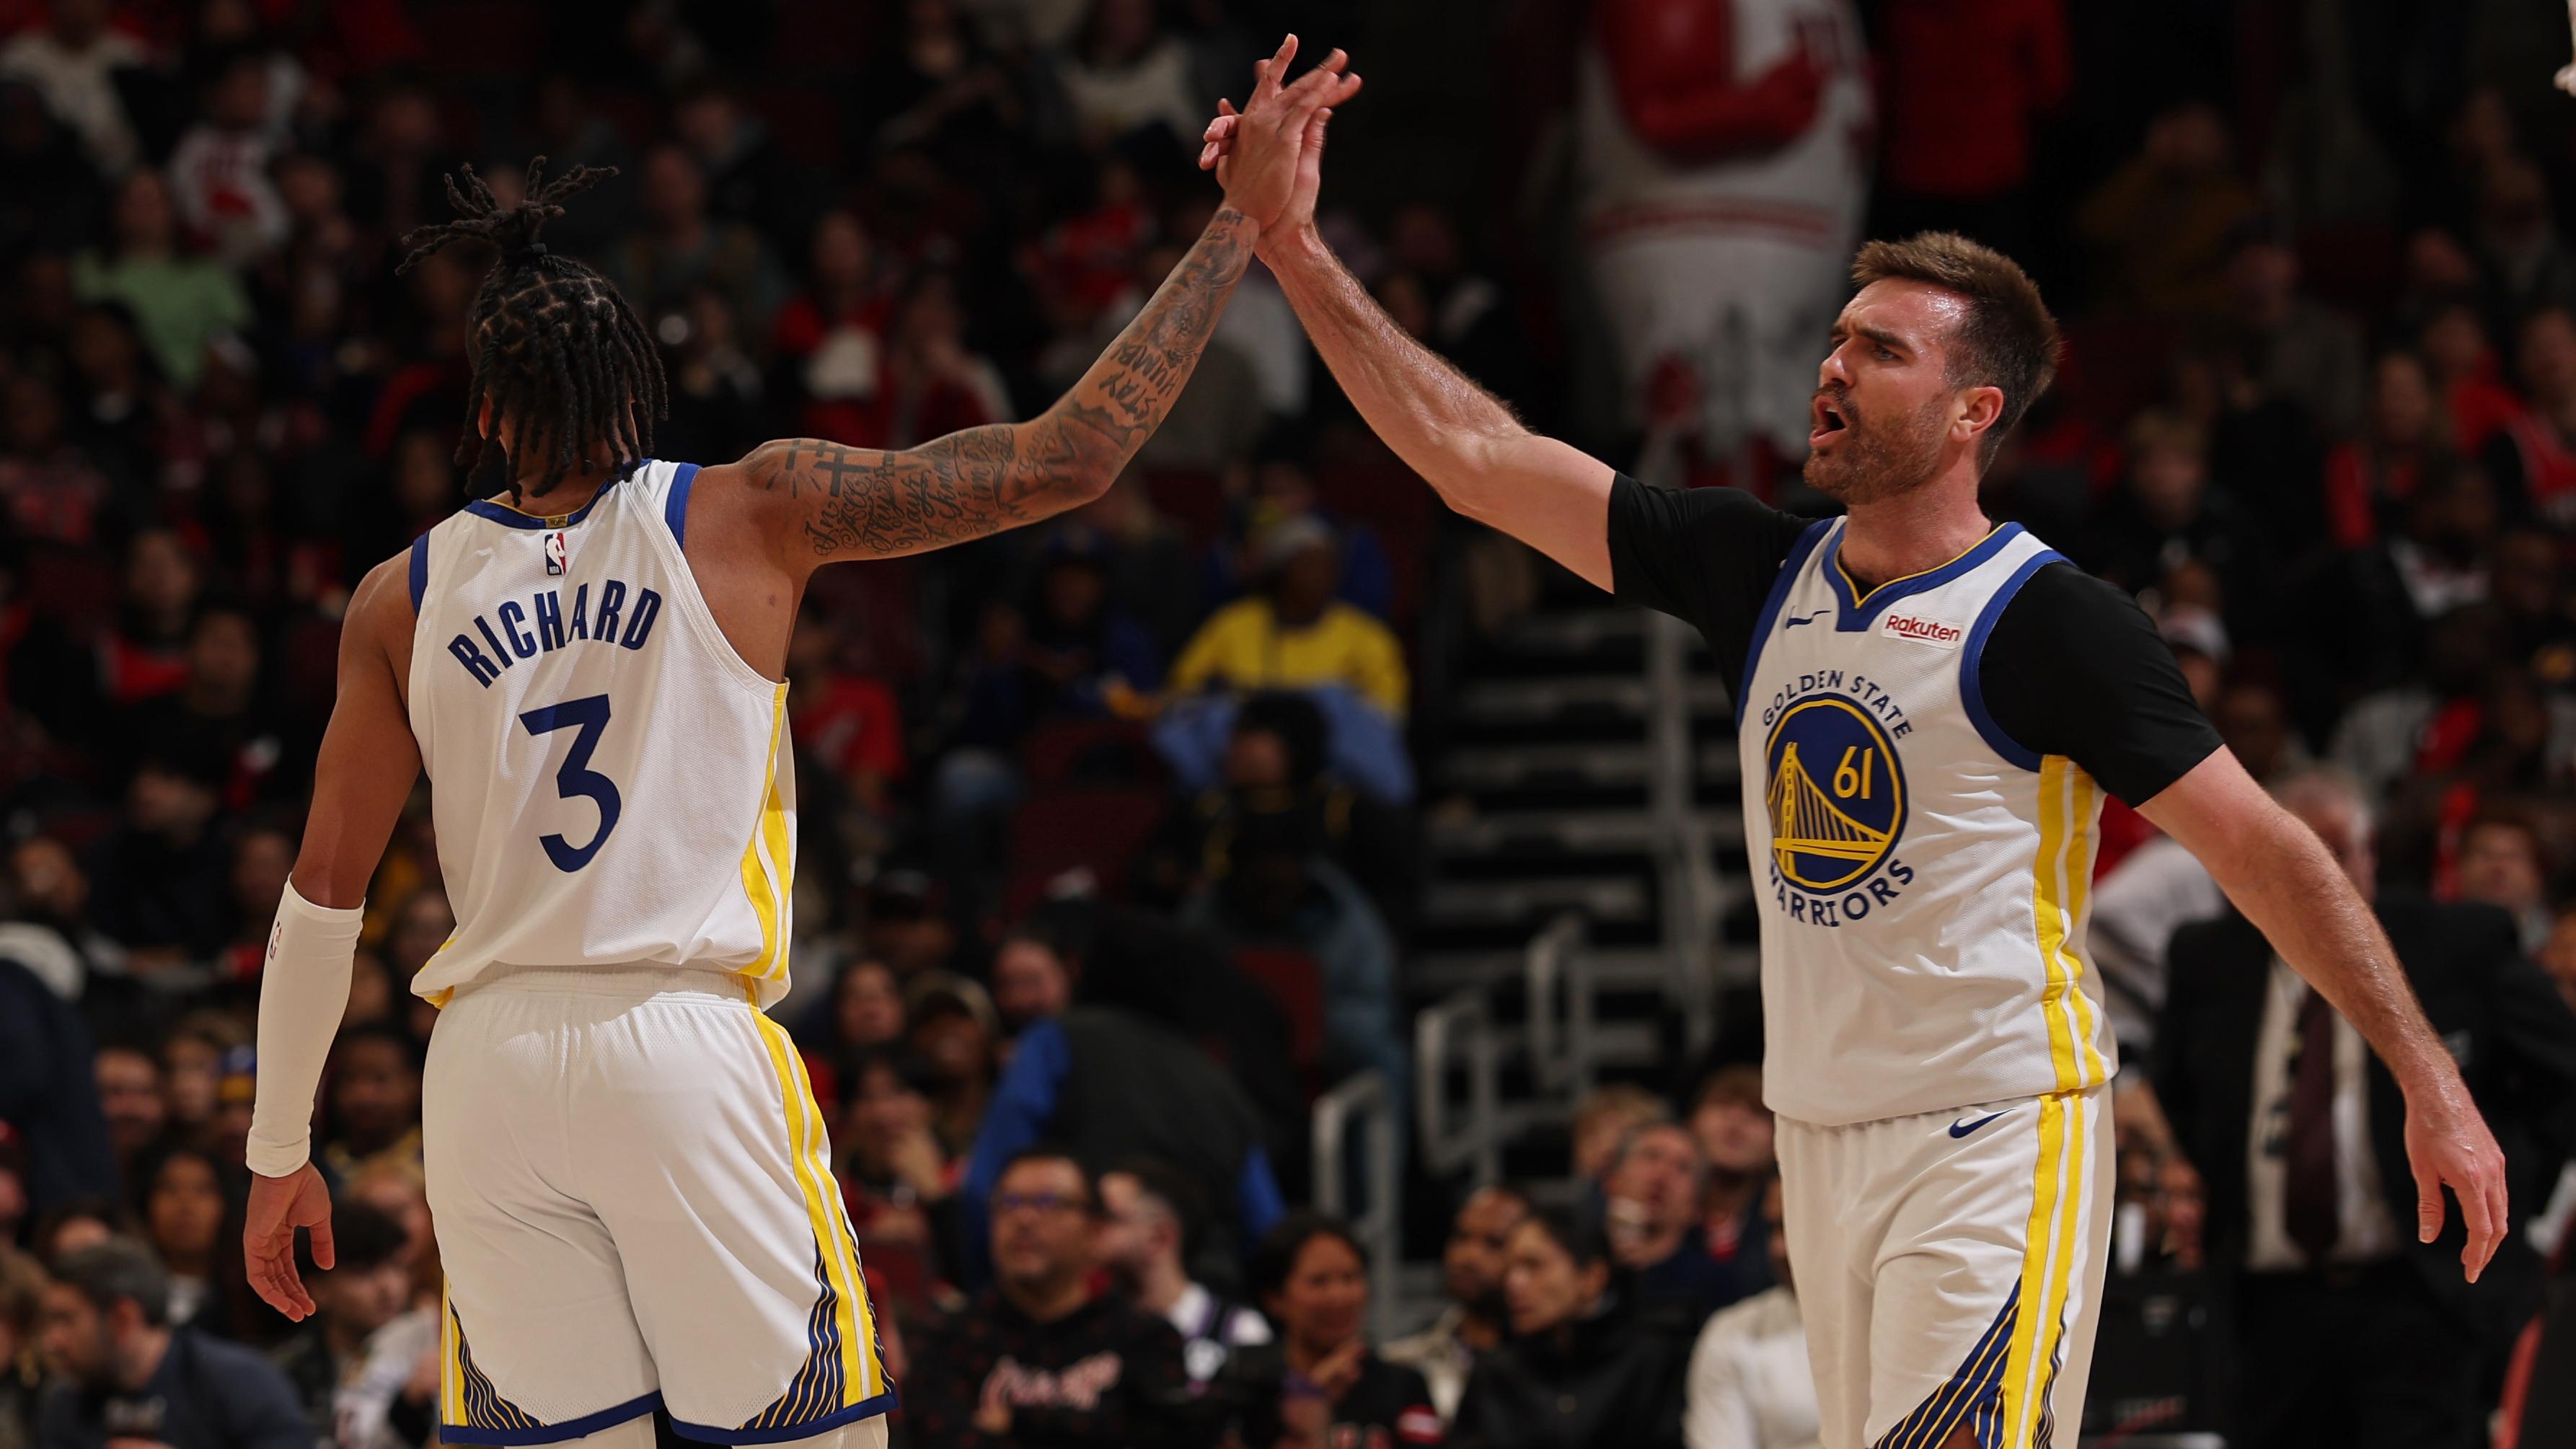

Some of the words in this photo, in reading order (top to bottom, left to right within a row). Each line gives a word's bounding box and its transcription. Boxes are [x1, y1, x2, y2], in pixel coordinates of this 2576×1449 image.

[447, 579, 662, 689] RICHARD
[1885, 615, 1960, 642] Rakuten
[1763, 669, 1844, 726] GOLDEN
[1850, 675, 1913, 739] STATE
[519, 693, 622, 873] 3
[1832, 745, 1874, 800] 61
[1770, 858, 1915, 927] WARRIORS
